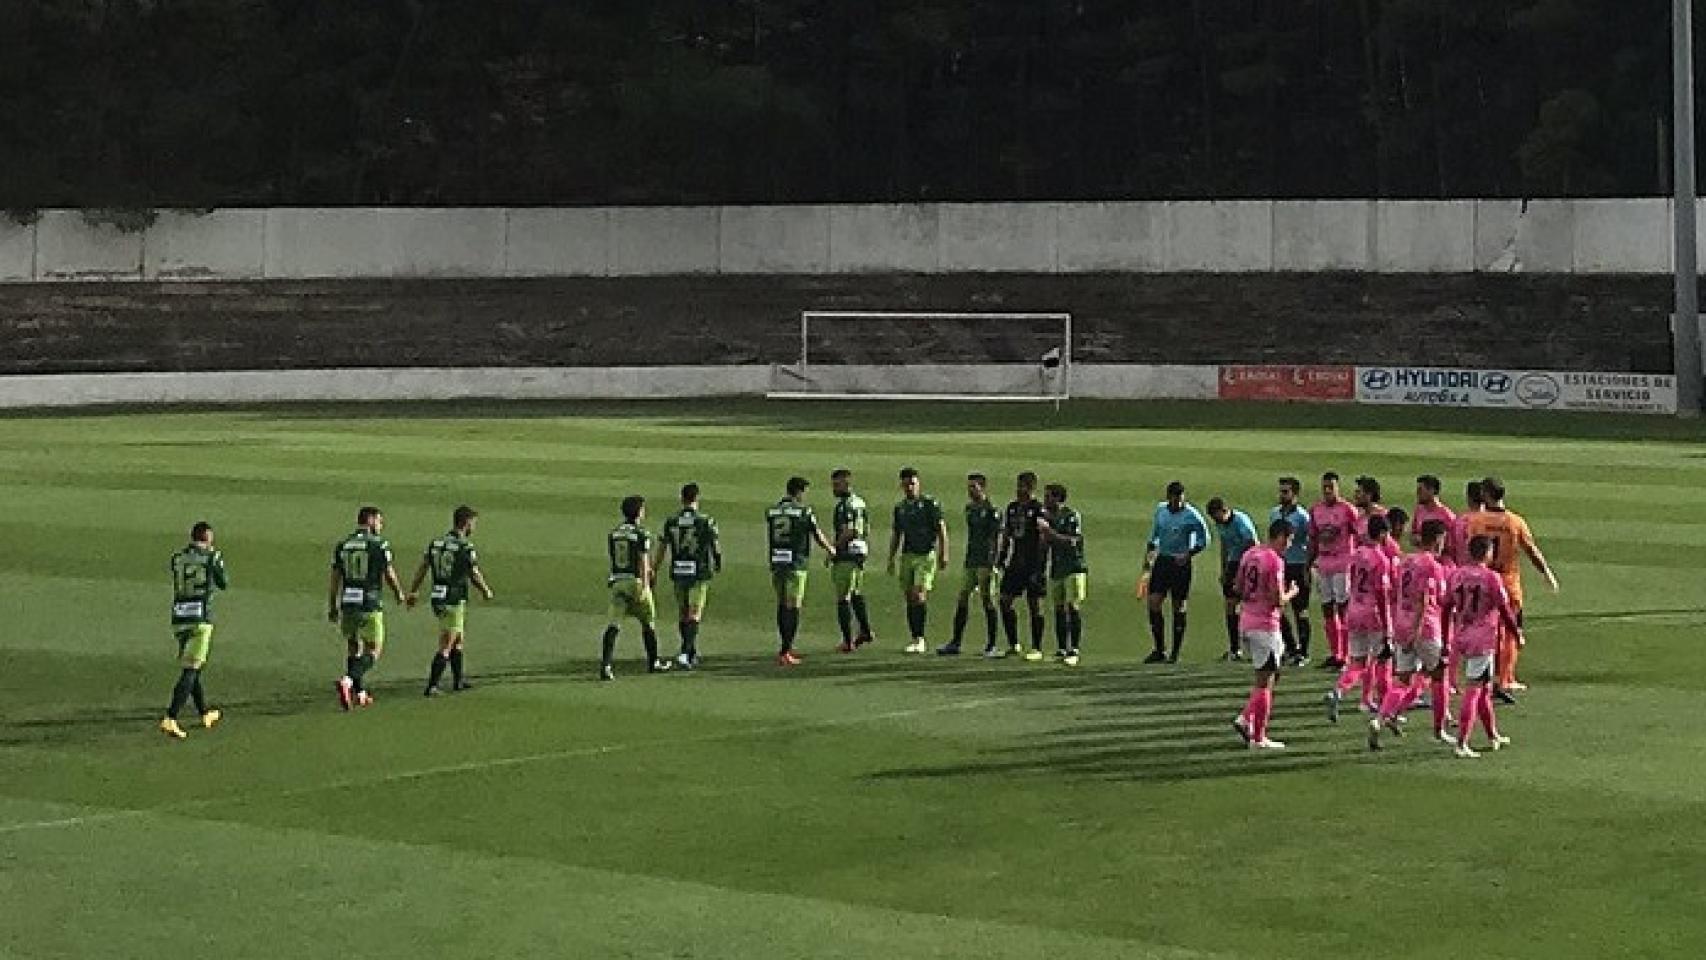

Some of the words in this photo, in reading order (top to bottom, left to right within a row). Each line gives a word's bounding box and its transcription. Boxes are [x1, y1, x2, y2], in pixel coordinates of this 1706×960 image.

[1396, 369, 1479, 388] HYUNDAI
[1563, 374, 1649, 388] ESTACIONES
[1585, 388, 1650, 400] SERVICIO
[340, 550, 369, 580] 10
